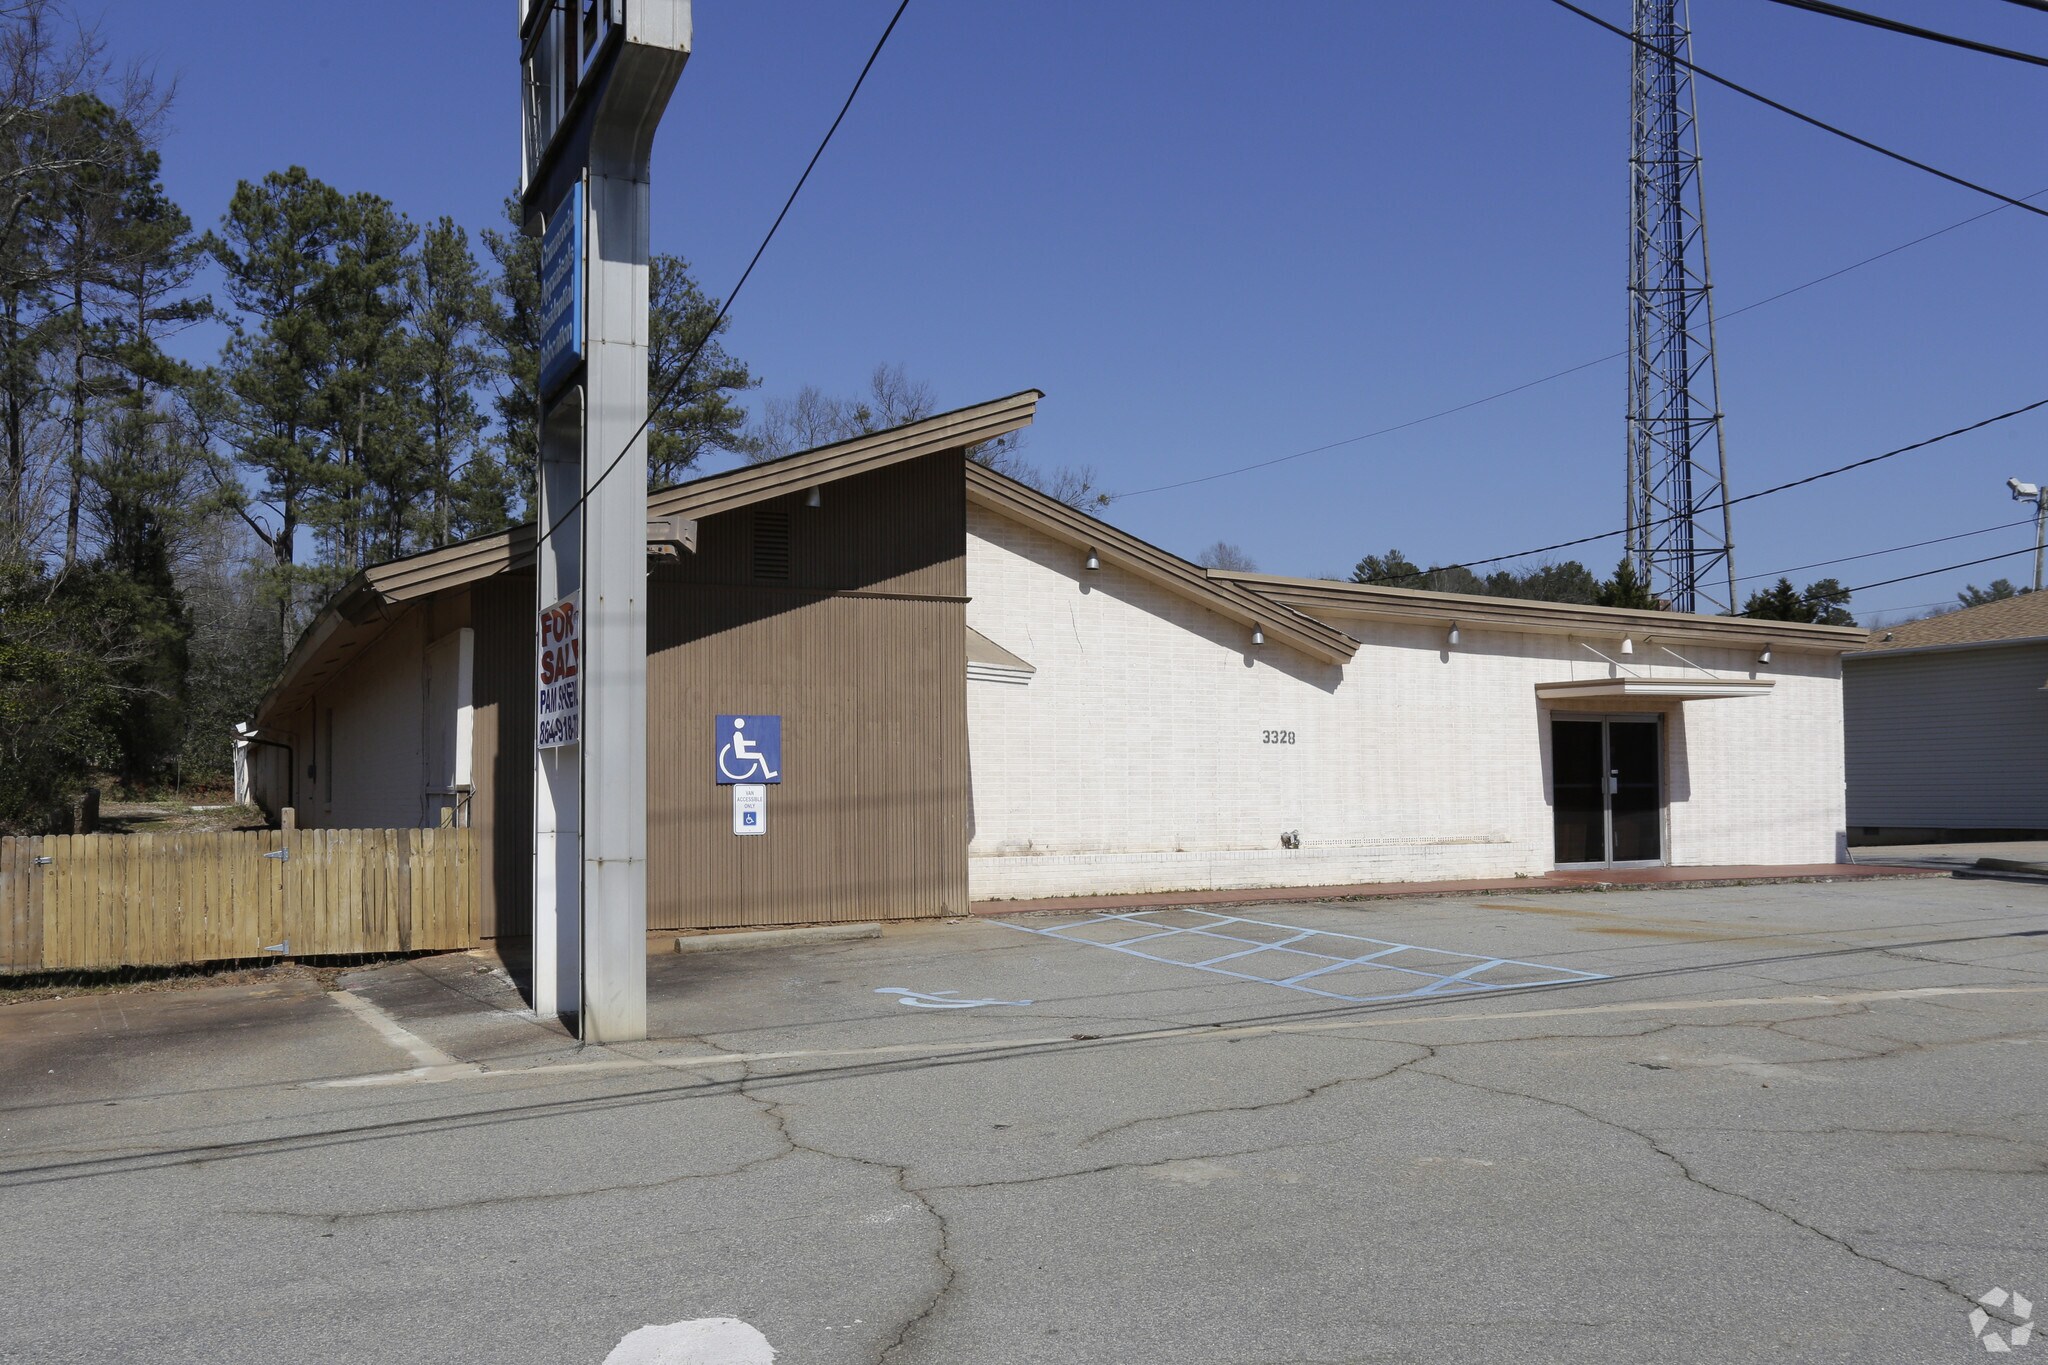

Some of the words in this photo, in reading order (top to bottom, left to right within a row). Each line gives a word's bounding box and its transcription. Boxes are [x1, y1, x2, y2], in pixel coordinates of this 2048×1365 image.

[541, 602, 574, 647] FOR
[540, 687, 557, 714] PAM
[1262, 729, 1296, 745] 3328
